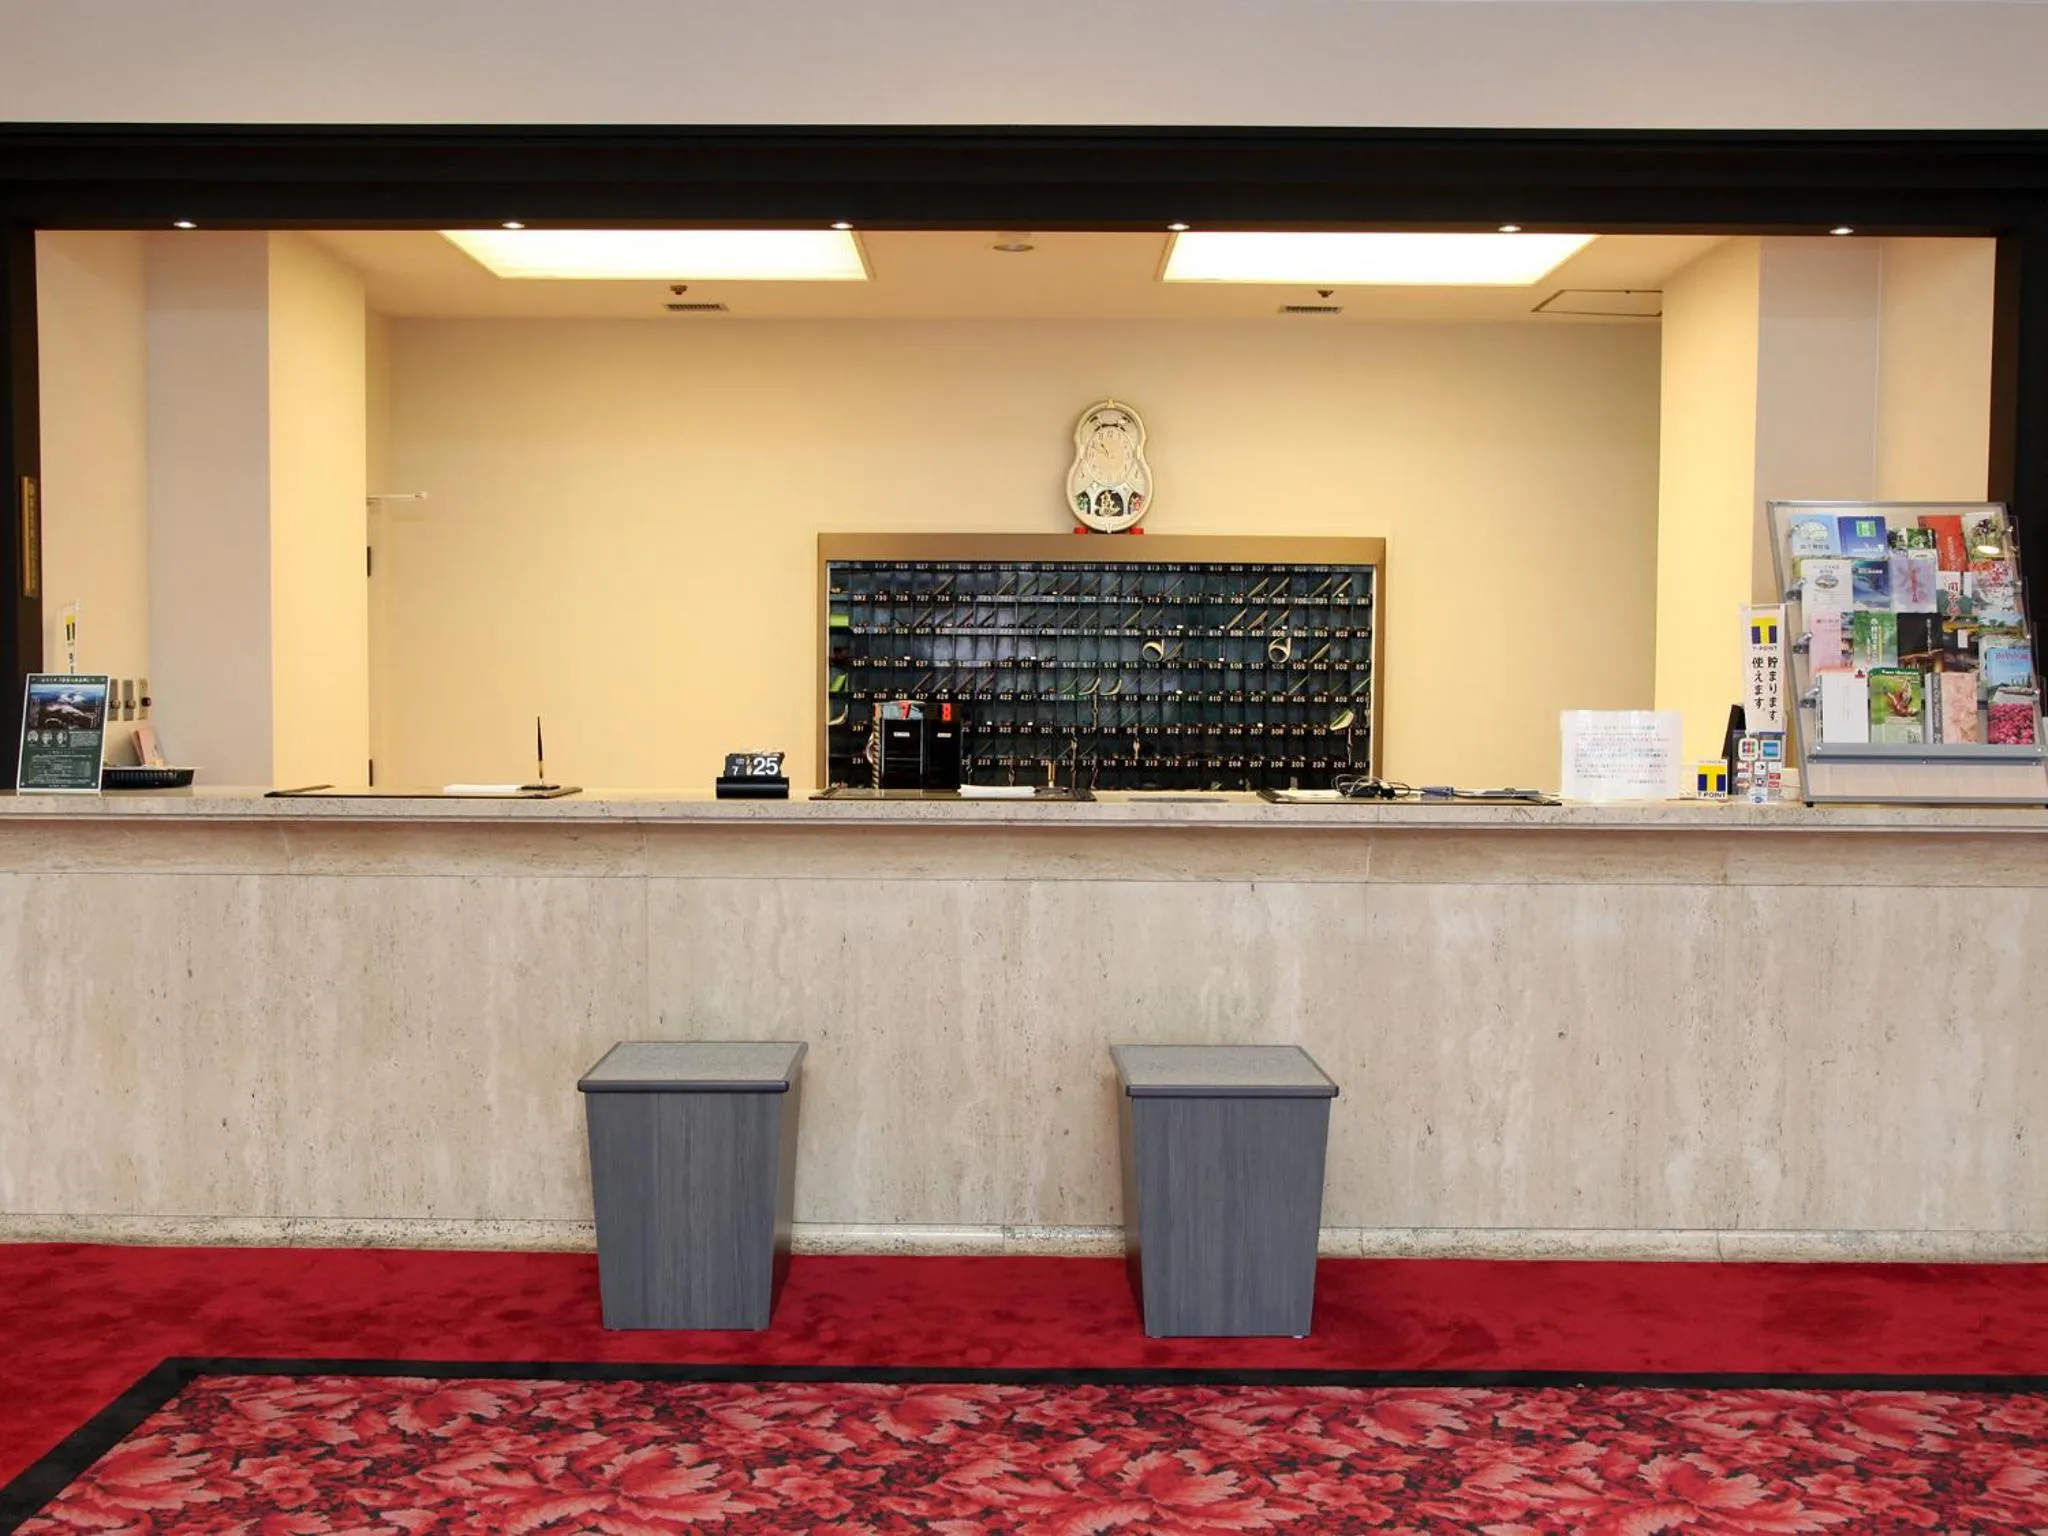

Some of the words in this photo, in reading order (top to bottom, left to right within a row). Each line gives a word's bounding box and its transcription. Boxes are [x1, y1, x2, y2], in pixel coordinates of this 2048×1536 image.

[1752, 657, 1766, 712] 使えます。
[1767, 656, 1779, 723] 貯まります。
[898, 701, 911, 719] 7
[942, 703, 952, 721] 8
[732, 766, 738, 775] 7
[753, 757, 778, 775] 25
